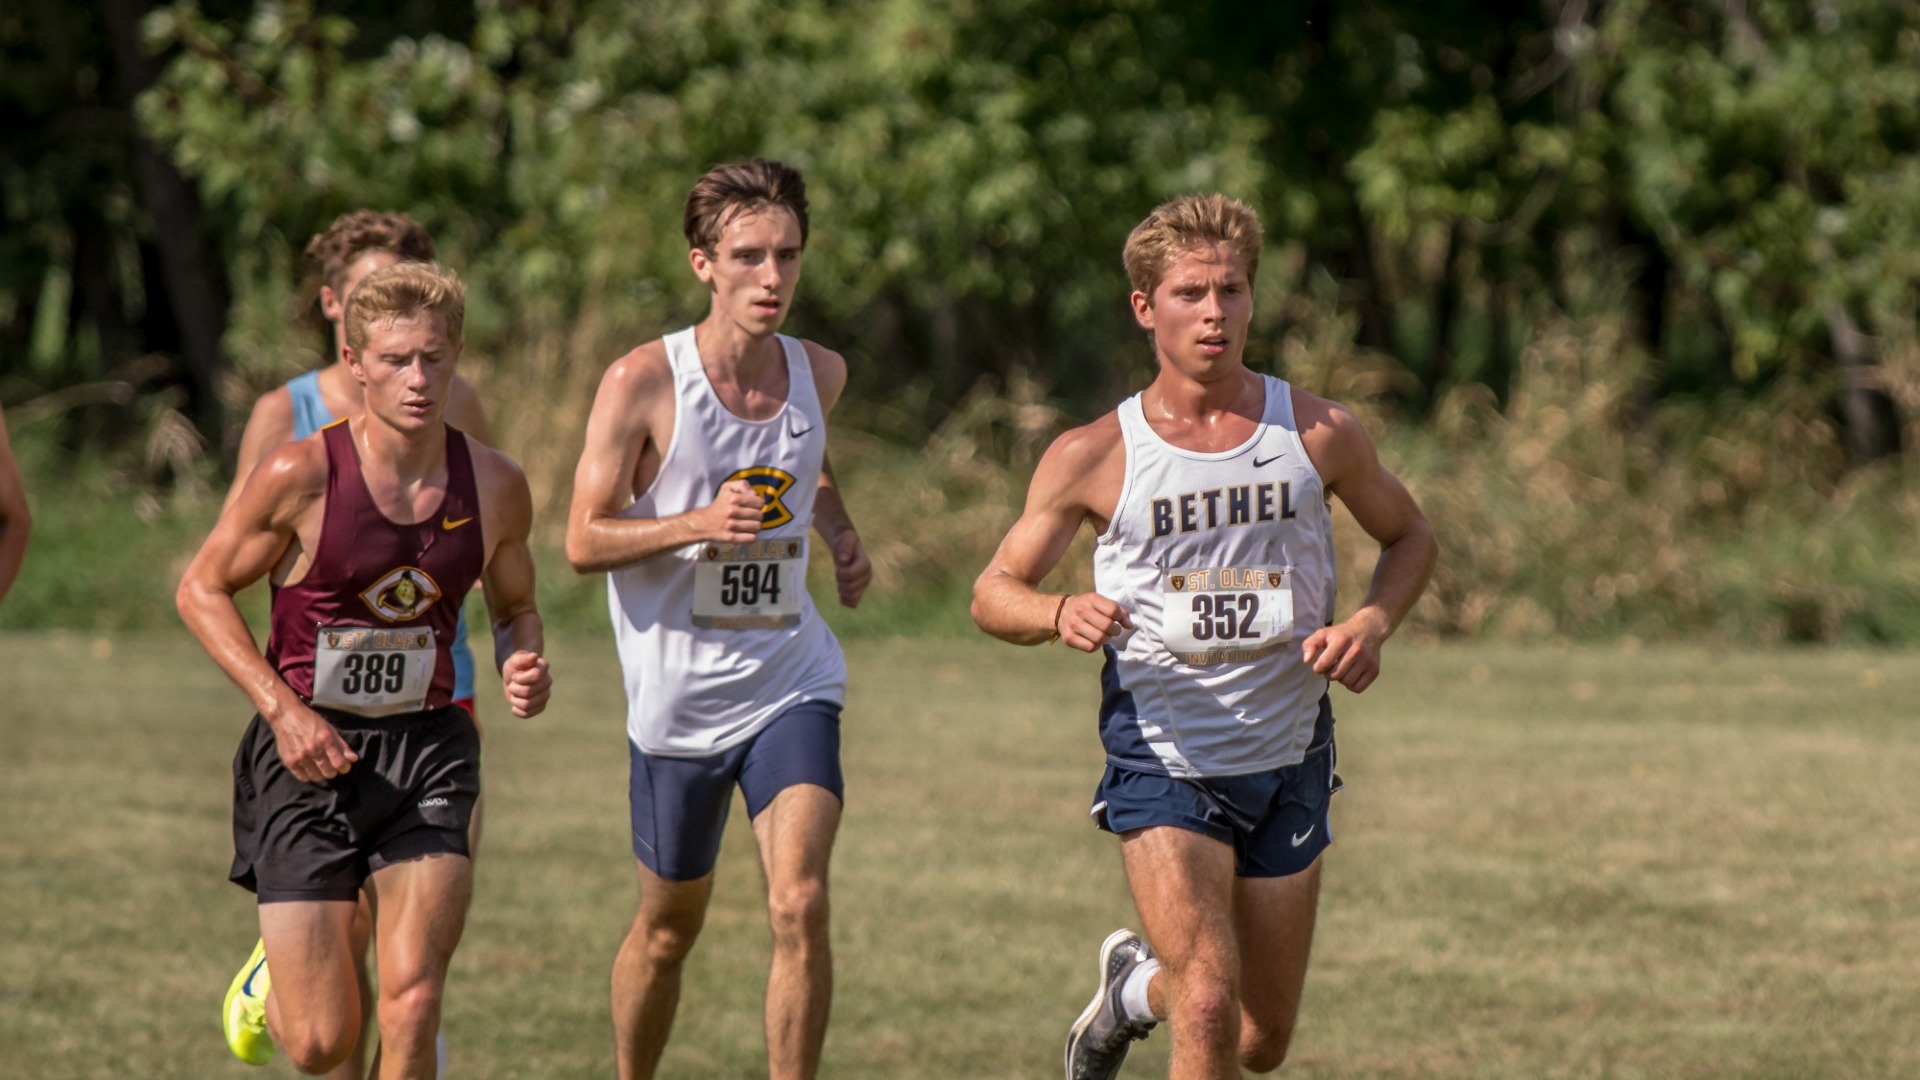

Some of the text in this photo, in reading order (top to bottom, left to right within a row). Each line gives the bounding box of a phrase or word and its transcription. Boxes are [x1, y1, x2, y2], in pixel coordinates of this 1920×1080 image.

[1150, 479, 1298, 538] BETHEL
[749, 541, 786, 558] OLAF
[721, 563, 781, 606] 594
[1187, 568, 1265, 592] ST. OLAF
[1191, 592, 1261, 641] 352
[342, 630, 414, 650] ST. OLAF
[342, 652, 406, 695] 389
